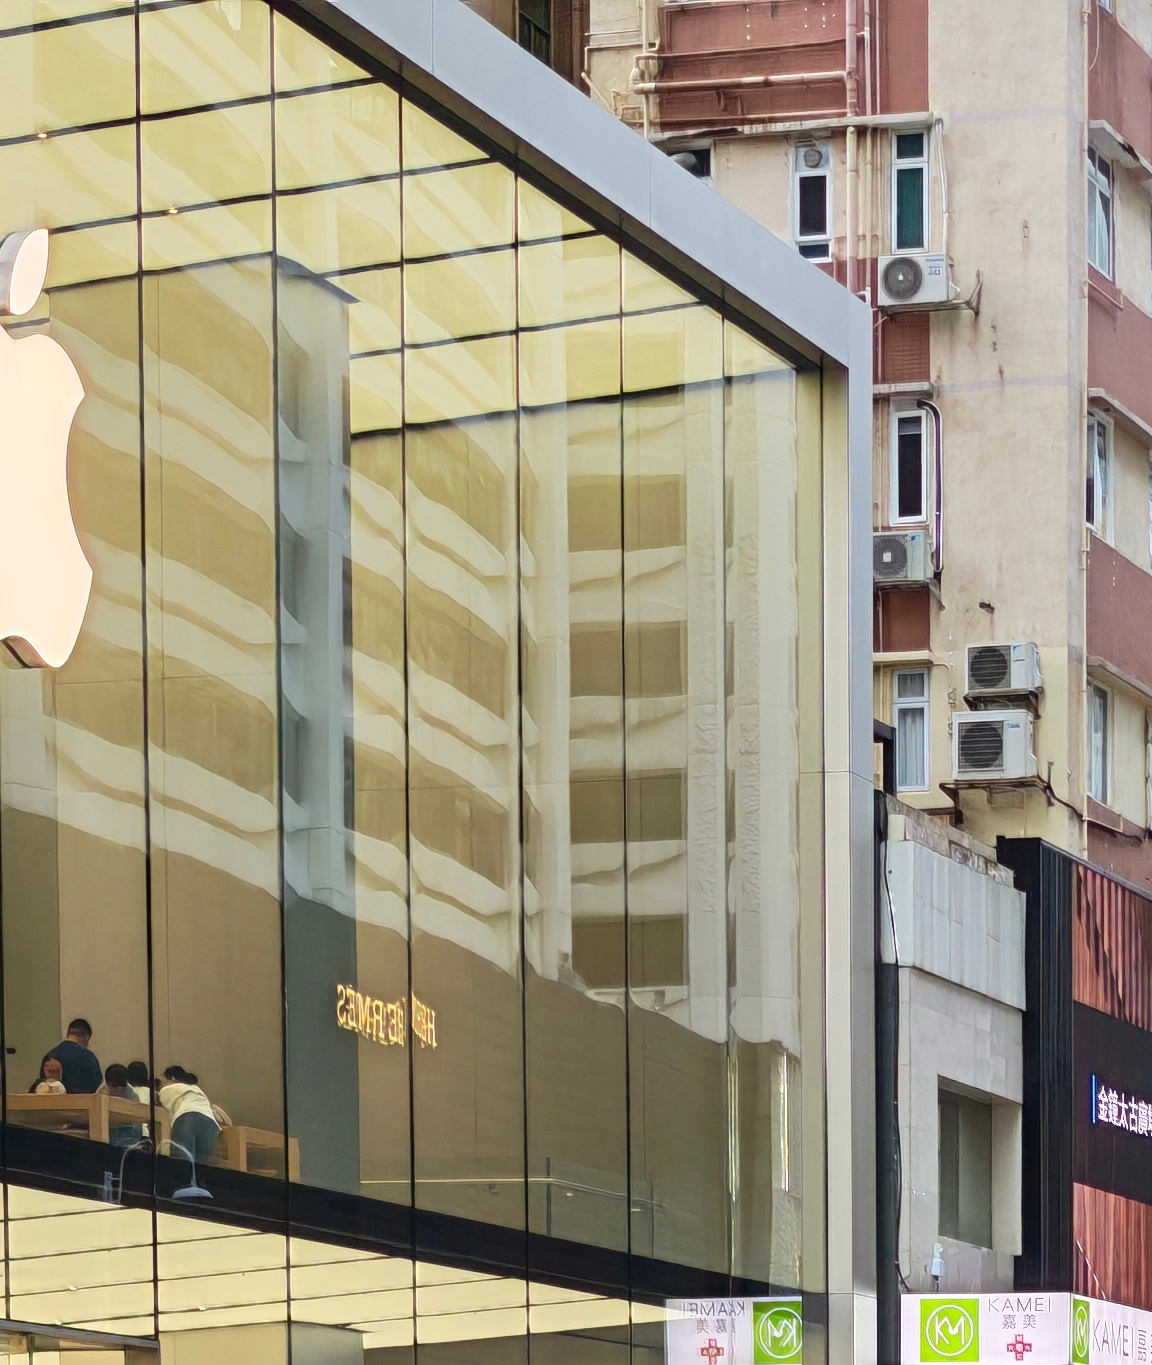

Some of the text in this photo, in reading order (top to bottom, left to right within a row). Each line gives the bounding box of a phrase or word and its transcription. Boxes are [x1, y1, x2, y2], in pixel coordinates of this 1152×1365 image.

[988, 1297, 1051, 1313] KAMEI
[1002, 1314, 1037, 1330] 嘉美
[1092, 1318, 1135, 1360] KAMEI
